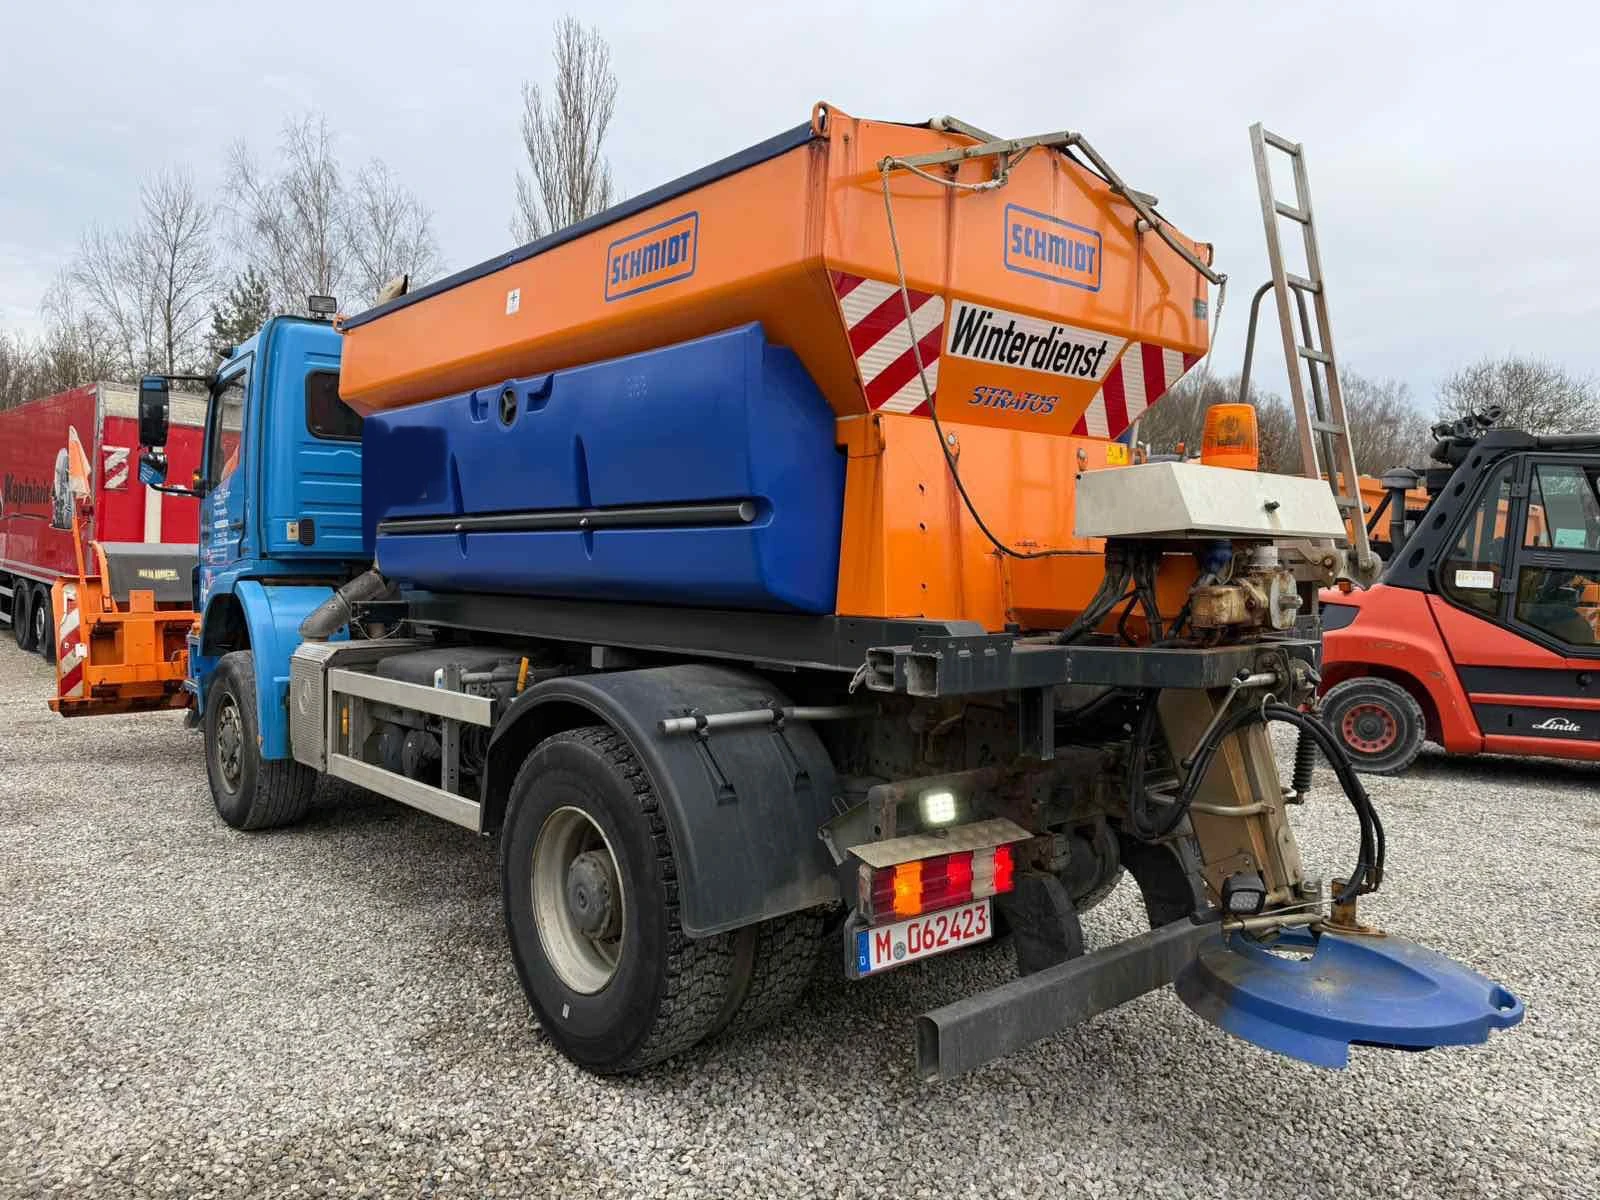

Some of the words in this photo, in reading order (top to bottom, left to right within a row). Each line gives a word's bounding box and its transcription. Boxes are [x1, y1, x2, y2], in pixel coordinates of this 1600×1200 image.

[612, 231, 690, 285] SCHMIDT
[1011, 224, 1096, 274] SCHMIDT
[950, 305, 1107, 378] Winterdienst
[968, 386, 1060, 414] STRATOS
[1532, 717, 1581, 731] Linde
[908, 905, 986, 954] 062423
